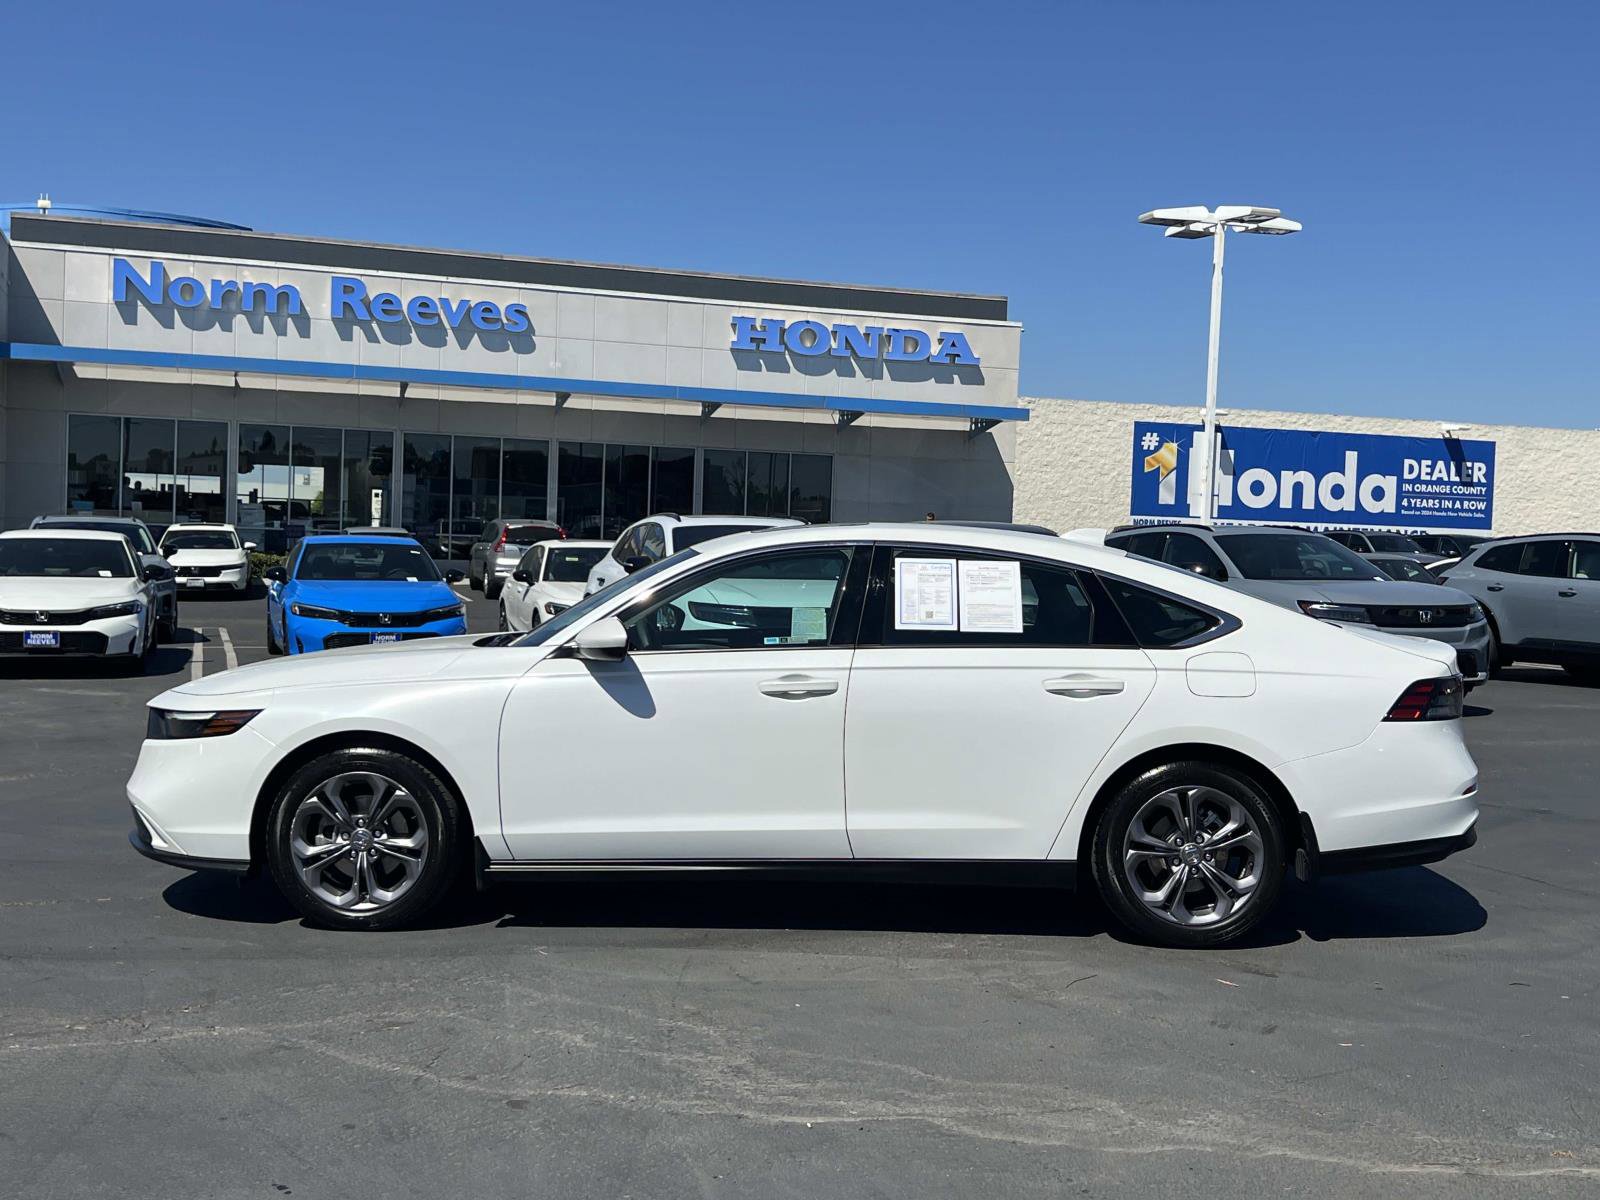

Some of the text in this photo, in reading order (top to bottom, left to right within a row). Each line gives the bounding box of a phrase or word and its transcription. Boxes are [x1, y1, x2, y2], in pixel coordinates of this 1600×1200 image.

[113, 258, 529, 333] Norm Reeves
[731, 316, 981, 366] HONDA
[1403, 458, 1487, 483] DEALER
[1402, 483, 1487, 495] IN ORANGE COUNTY
[1401, 498, 1487, 510] 4 YEARS IN A ROW
[1133, 518, 1155, 526] NORM
